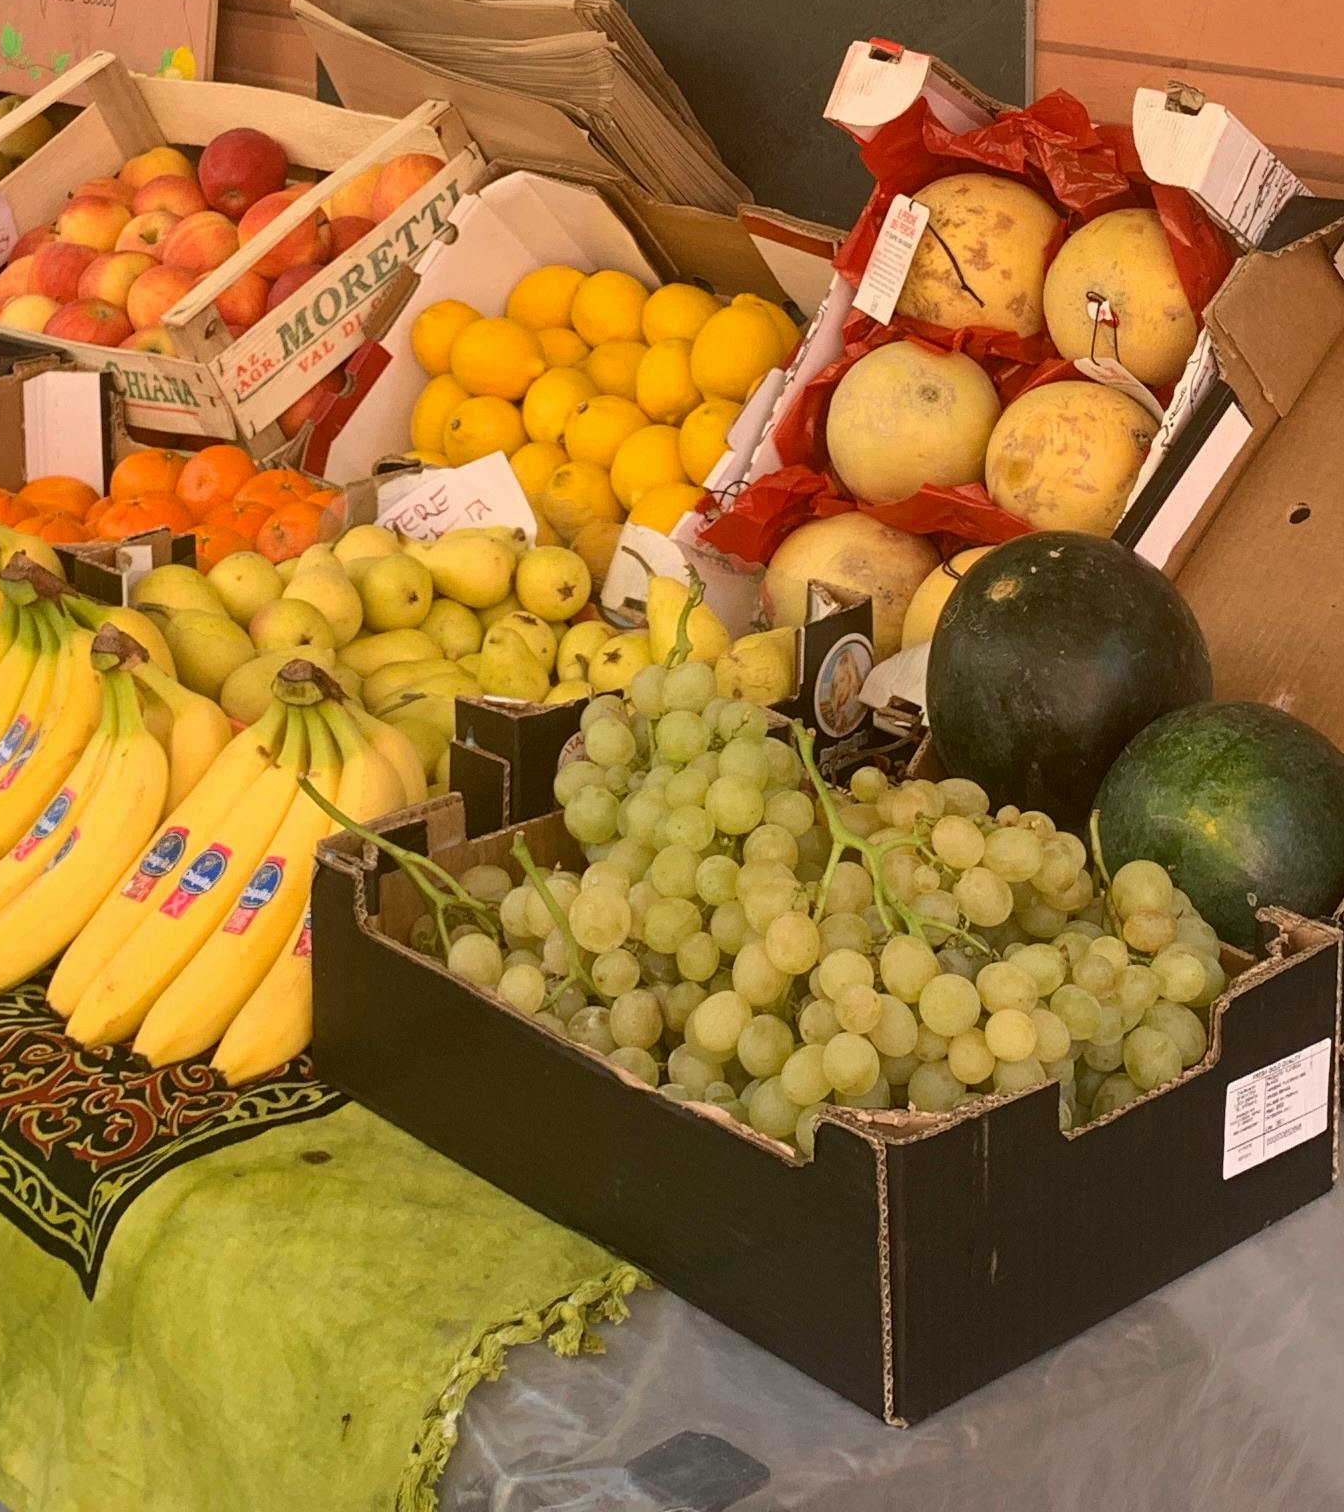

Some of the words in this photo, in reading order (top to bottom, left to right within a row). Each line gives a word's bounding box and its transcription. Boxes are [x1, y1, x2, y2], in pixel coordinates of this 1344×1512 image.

[275, 178, 462, 362] MORETTI
[296, 339, 336, 374] VAL
[340, 311, 364, 339] DI
[238, 356, 282, 394] AGR.
